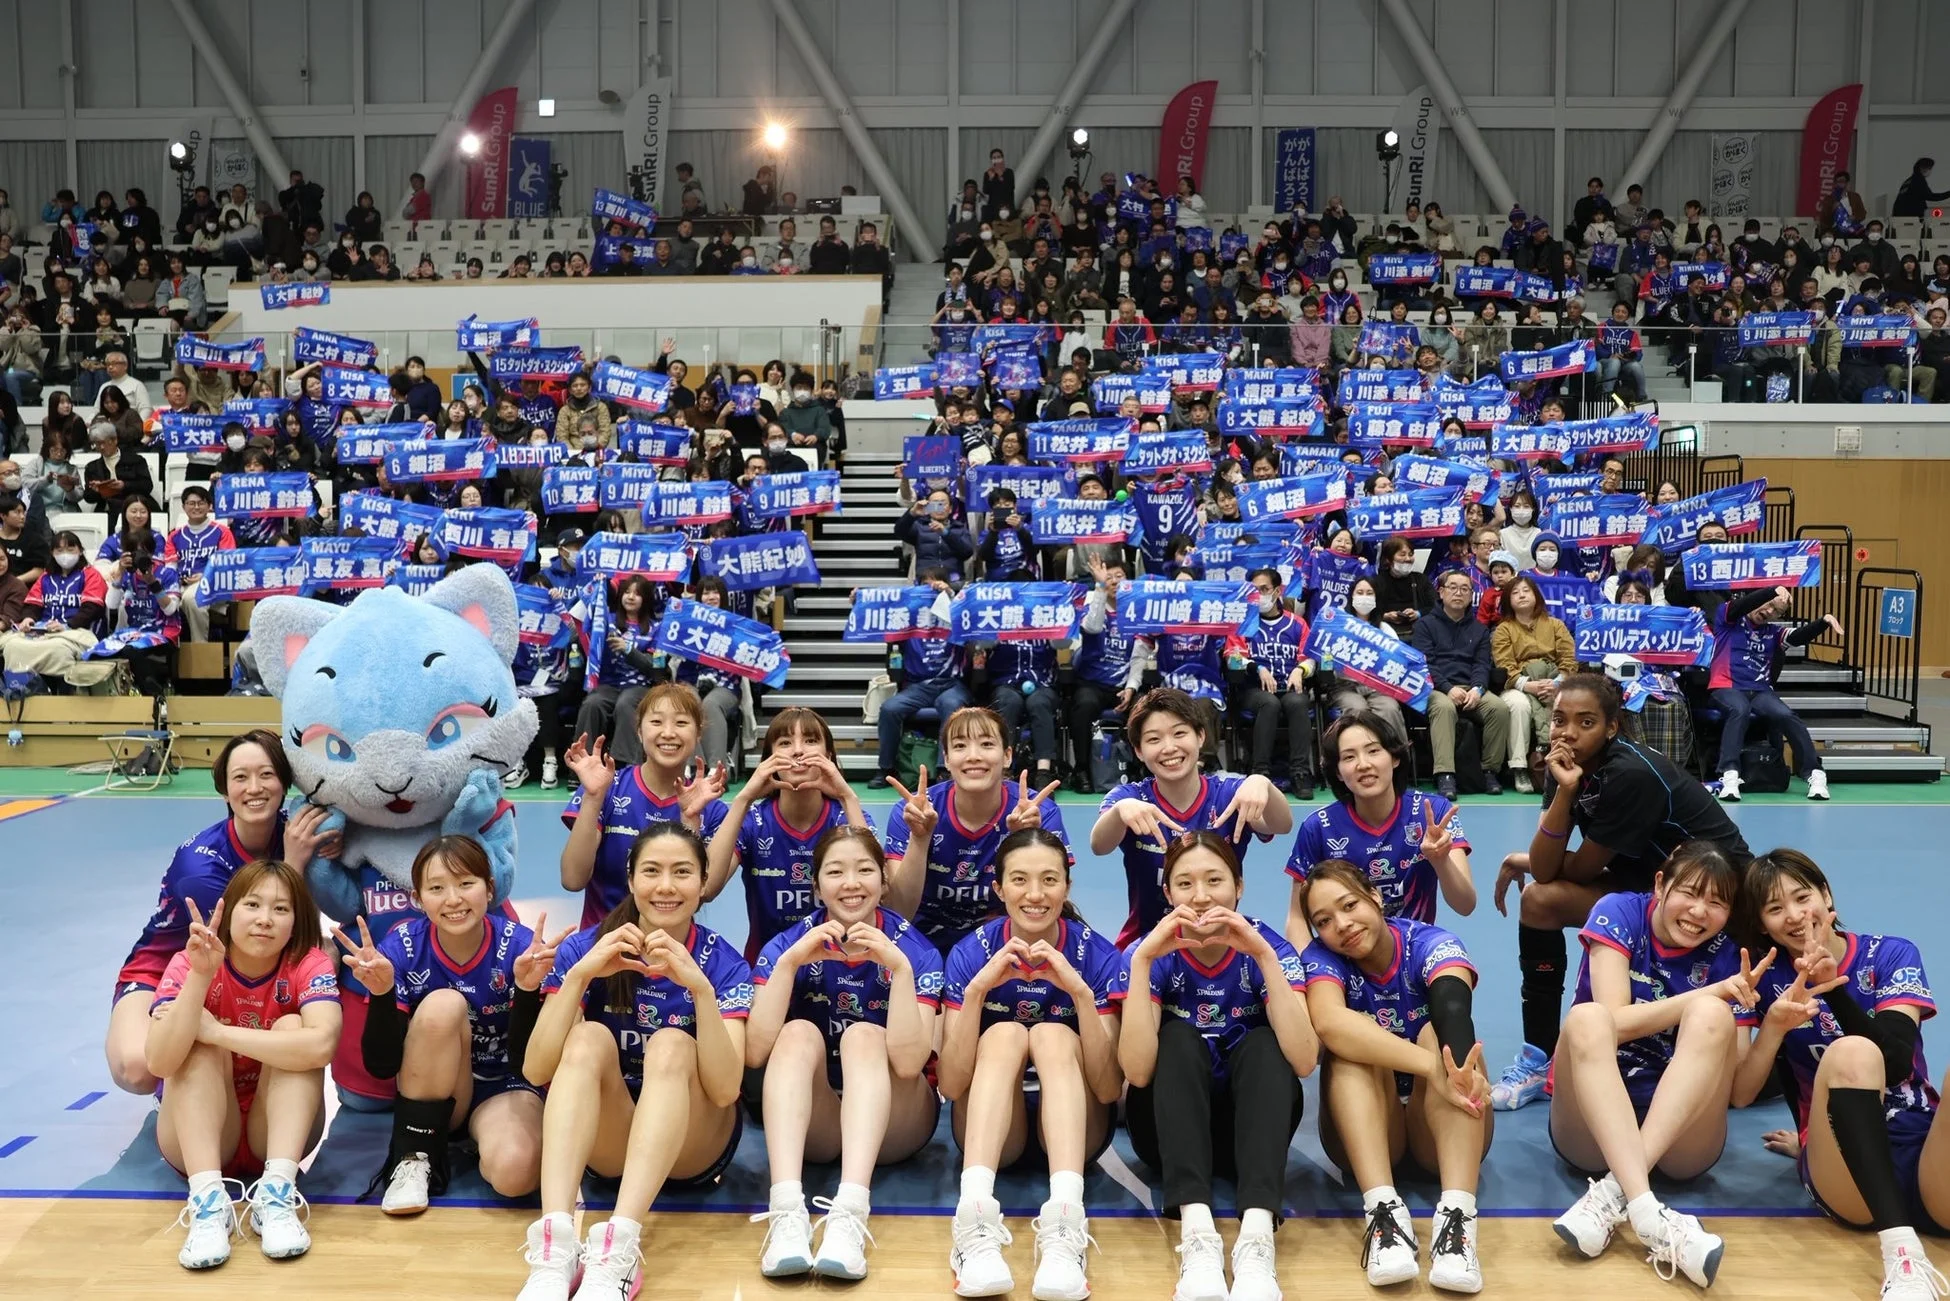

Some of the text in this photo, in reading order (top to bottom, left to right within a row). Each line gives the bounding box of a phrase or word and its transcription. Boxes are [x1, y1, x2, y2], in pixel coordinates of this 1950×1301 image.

[1284, 138, 1297, 210] がんばろう
[515, 203, 544, 217] BLUE
[595, 200, 605, 211] 13
[1374, 268, 1381, 278] 9
[1459, 280, 1465, 289] 6
[268, 294, 274, 304] 8
[1754, 316, 1776, 324] MIYU
[1851, 317, 1873, 325] MIYU
[312, 332, 338, 344] ANNA
[985, 329, 1005, 337] KISA
[1744, 330, 1750, 340] 9
[461, 335, 467, 345] 6
[180, 344, 190, 357] 13
[299, 342, 338, 360] 12 上村
[976, 342, 981, 353] 8
[495, 359, 506, 372] 15
[1155, 357, 1179, 366] KISA
[608, 365, 637, 379] MAMI
[1508, 362, 1514, 375] 6
[340, 372, 364, 382] KISA
[1244, 371, 1273, 380] MAMI
[1357, 373, 1384, 381] MIYU
[328, 385, 334, 397] 8
[598, 380, 601, 390] 1
[879, 382, 886, 394] 2
[1234, 386, 1239, 398] 1
[1346, 386, 1352, 399] 9
[1440, 392, 1465, 402] KISA
[227, 401, 253, 411] MIYU
[1367, 406, 1392, 416] FUJI
[1227, 411, 1235, 426] 8
[355, 428, 379, 436] FUJI
[636, 426, 653, 435] AYA
[1052, 424, 1098, 433] TAMAKI
[1355, 422, 1361, 437] 3
[171, 429, 215, 445] 5 大村
[343, 442, 349, 457] 3
[404, 441, 427, 451] AYA
[627, 440, 633, 452] 6
[1035, 435, 1088, 453] 11 松井
[1455, 440, 1486, 451] ANNA
[1492, 438, 1499, 452] 8
[1295, 446, 1340, 457] TAMAKI
[392, 459, 400, 475] 6
[621, 468, 651, 478] MIYU
[1281, 459, 1291, 475] 11
[559, 471, 592, 480] MAYU
[771, 474, 801, 485] MIYU
[231, 477, 265, 488] RENA
[659, 484, 691, 494] RENA
[1259, 478, 1284, 490] AYA
[545, 490, 558, 505] 10
[608, 484, 615, 500] 9
[218, 497, 227, 511] 4
[361, 498, 392, 514] KISA
[759, 493, 768, 509] 9
[1057, 499, 1109, 510] TAMAKI
[1148, 494, 1184, 505] KAWAZOE
[1371, 495, 1408, 505] ANNA
[1557, 500, 1593, 512] RENA
[648, 502, 655, 518] 4
[1248, 499, 1258, 517] 6
[1671, 499, 1709, 516] ANNA
[344, 513, 352, 528] 8
[1039, 514, 1097, 534] 11 松井
[1158, 506, 1172, 533] 9
[1354, 514, 1369, 531] 12
[1373, 510, 1414, 530] 上村
[1215, 527, 1242, 538] FUJI
[1658, 525, 1675, 544] 12
[312, 542, 350, 553] MAYU
[211, 553, 245, 565] MIYU
[581, 550, 597, 568] 13
[1202, 550, 1232, 563] FUJI
[406, 565, 440, 577] MIYU
[1691, 562, 1707, 581] 13
[1711, 558, 1754, 580] 西川
[200, 579, 209, 596] 9
[1144, 581, 1186, 593] RENA
[1321, 579, 1349, 593] VALDES
[862, 589, 902, 602] MIYU
[976, 588, 1012, 601] KISA
[1890, 596, 1904, 613] A3
[691, 605, 726, 628] KISA
[961, 609, 971, 630] 8
[978, 606, 1025, 630] 大熊
[1125, 605, 1136, 622] 4
[1602, 607, 1640, 622] MELI
[1888, 616, 1904, 624] ブロック
[849, 617, 856, 632] 9
[667, 621, 680, 641] 8
[683, 626, 732, 658] 大熊
[1343, 618, 1398, 653] TAMAKI
[1580, 630, 1600, 651] 23
[1314, 629, 1331, 650] 11
[1327, 637, 1379, 671] 松井
[937, 885, 989, 902] PFU
[394, 922, 414, 958] RICOH
[497, 921, 516, 961] RICOH
[837, 977, 864, 988] SPALDING
[1016, 984, 1047, 996] SPALDING
[1196, 988, 1225, 997] SPALDING
